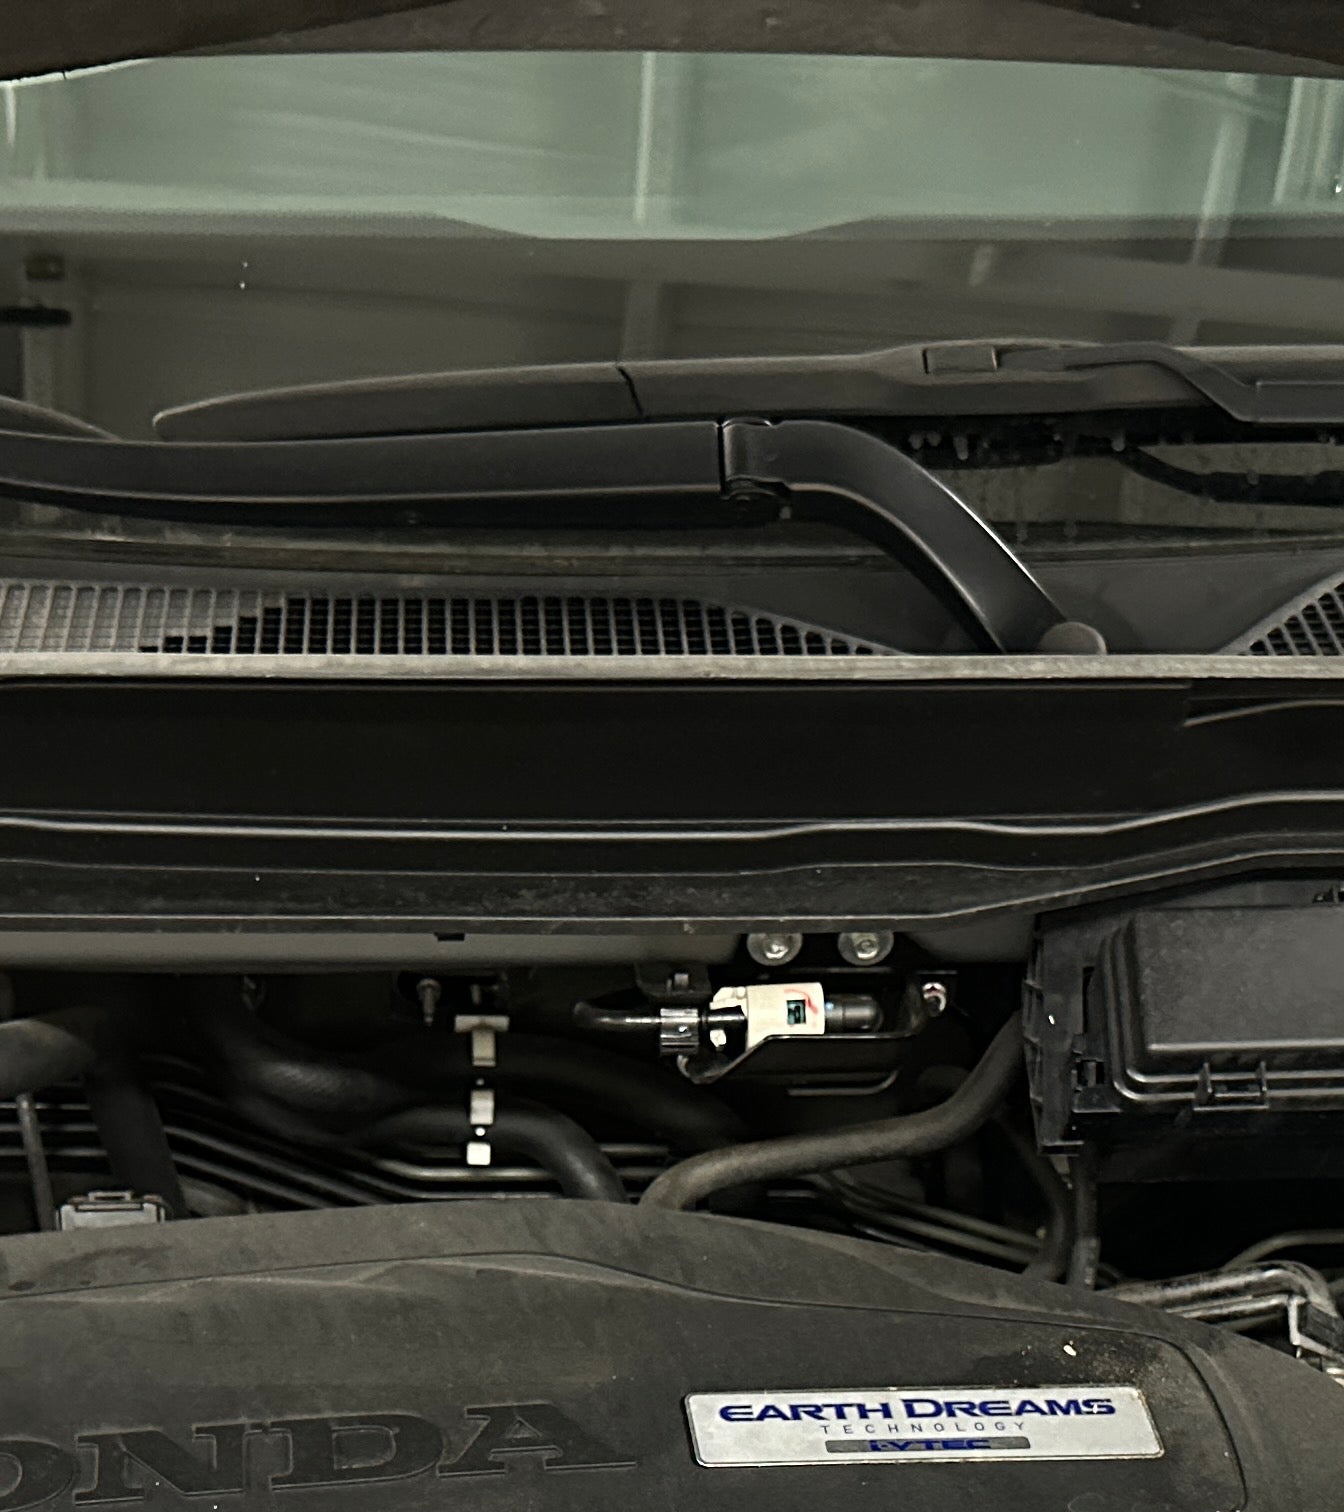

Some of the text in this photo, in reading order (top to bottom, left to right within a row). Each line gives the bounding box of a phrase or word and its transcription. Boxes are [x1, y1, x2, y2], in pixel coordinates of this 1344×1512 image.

[719, 1397, 1116, 1421] EARTH DREAMS
[820, 1421, 1025, 1435] TECHNOLOGY
